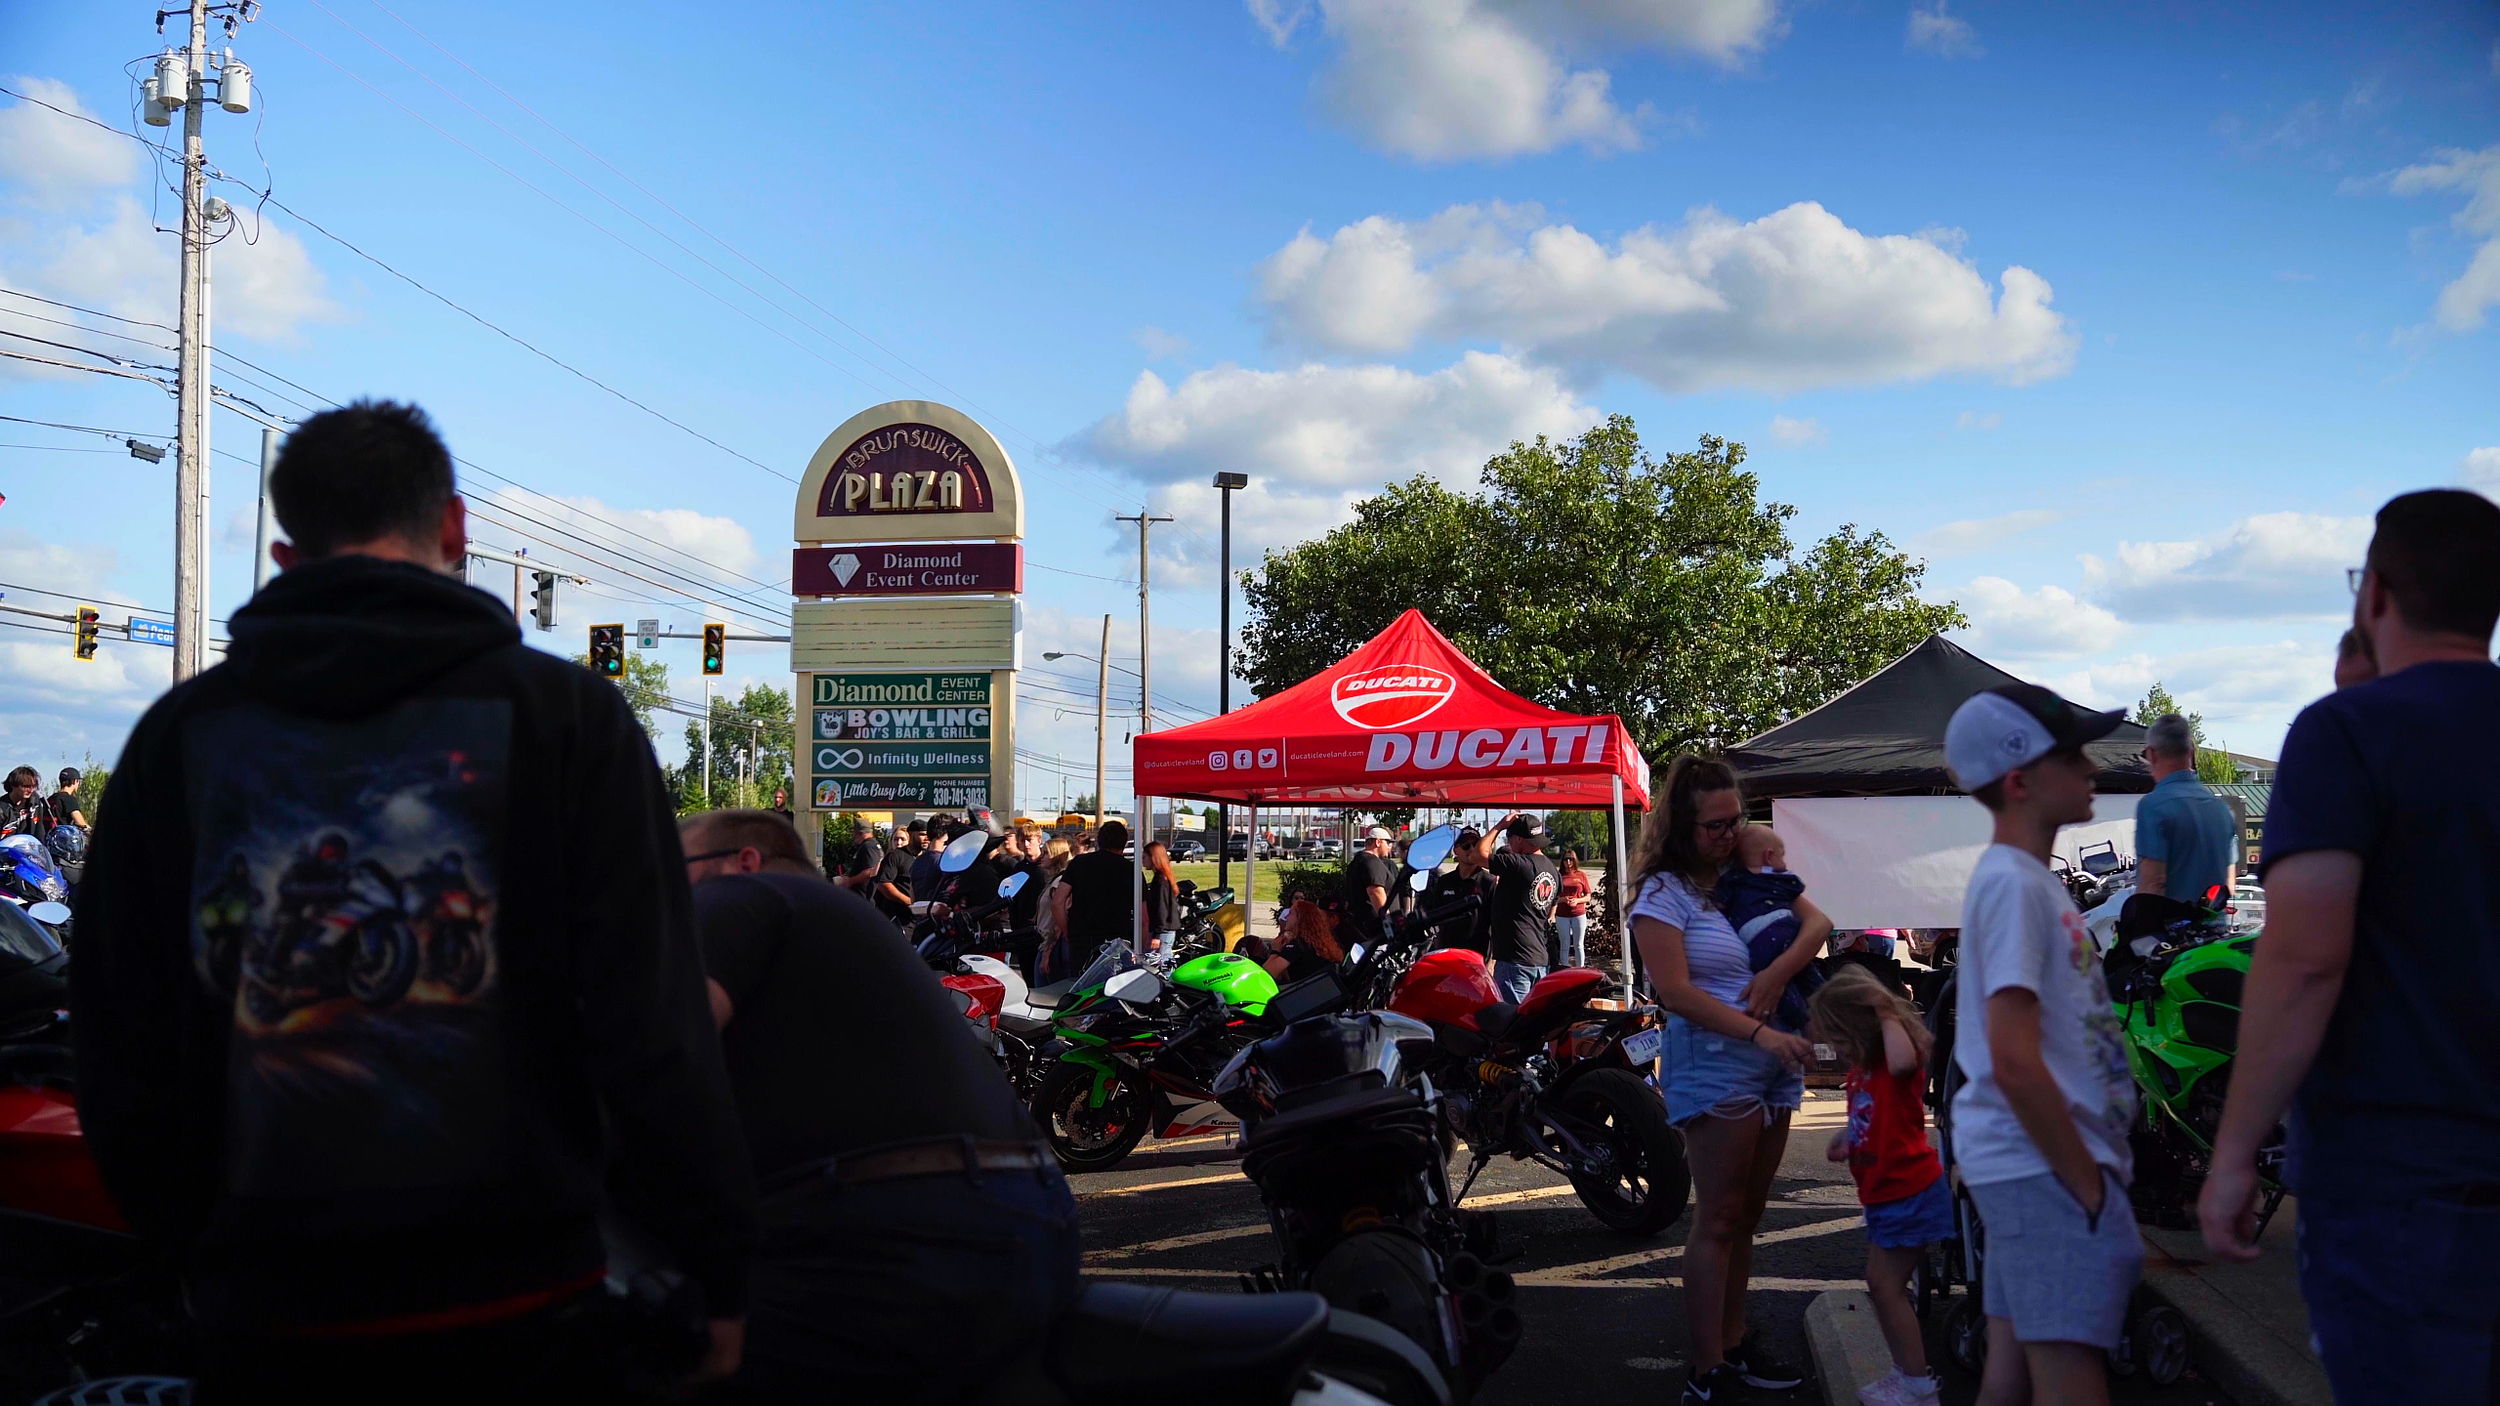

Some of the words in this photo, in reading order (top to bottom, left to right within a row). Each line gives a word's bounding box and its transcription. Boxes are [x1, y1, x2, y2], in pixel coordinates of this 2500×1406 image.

[847, 429, 970, 469] BRUNSWICK
[845, 470, 963, 511] PLAZA
[883, 552, 962, 569] Diamond
[866, 572, 914, 588] Event
[921, 570, 979, 586] Center
[150, 625, 174, 642] Pear
[816, 678, 933, 702] Diamond
[941, 677, 981, 688] EVENT
[1346, 677, 1443, 692] DUCATI
[936, 690, 985, 701] CENTER
[847, 708, 989, 727] BOWLING
[854, 728, 889, 739] JOY'S
[895, 727, 919, 738] BAR
[926, 727, 935, 738] &
[941, 727, 976, 738] GRILL
[1143, 758, 1205, 769] @ducaticleveland
[1290, 750, 1364, 761] ducaticleveland.com
[1365, 724, 1609, 772] DUCATI
[868, 752, 919, 767] Infinity
[923, 752, 984, 764] Wellness
[842, 782, 869, 799] Little
[870, 783, 896, 800] Busy
